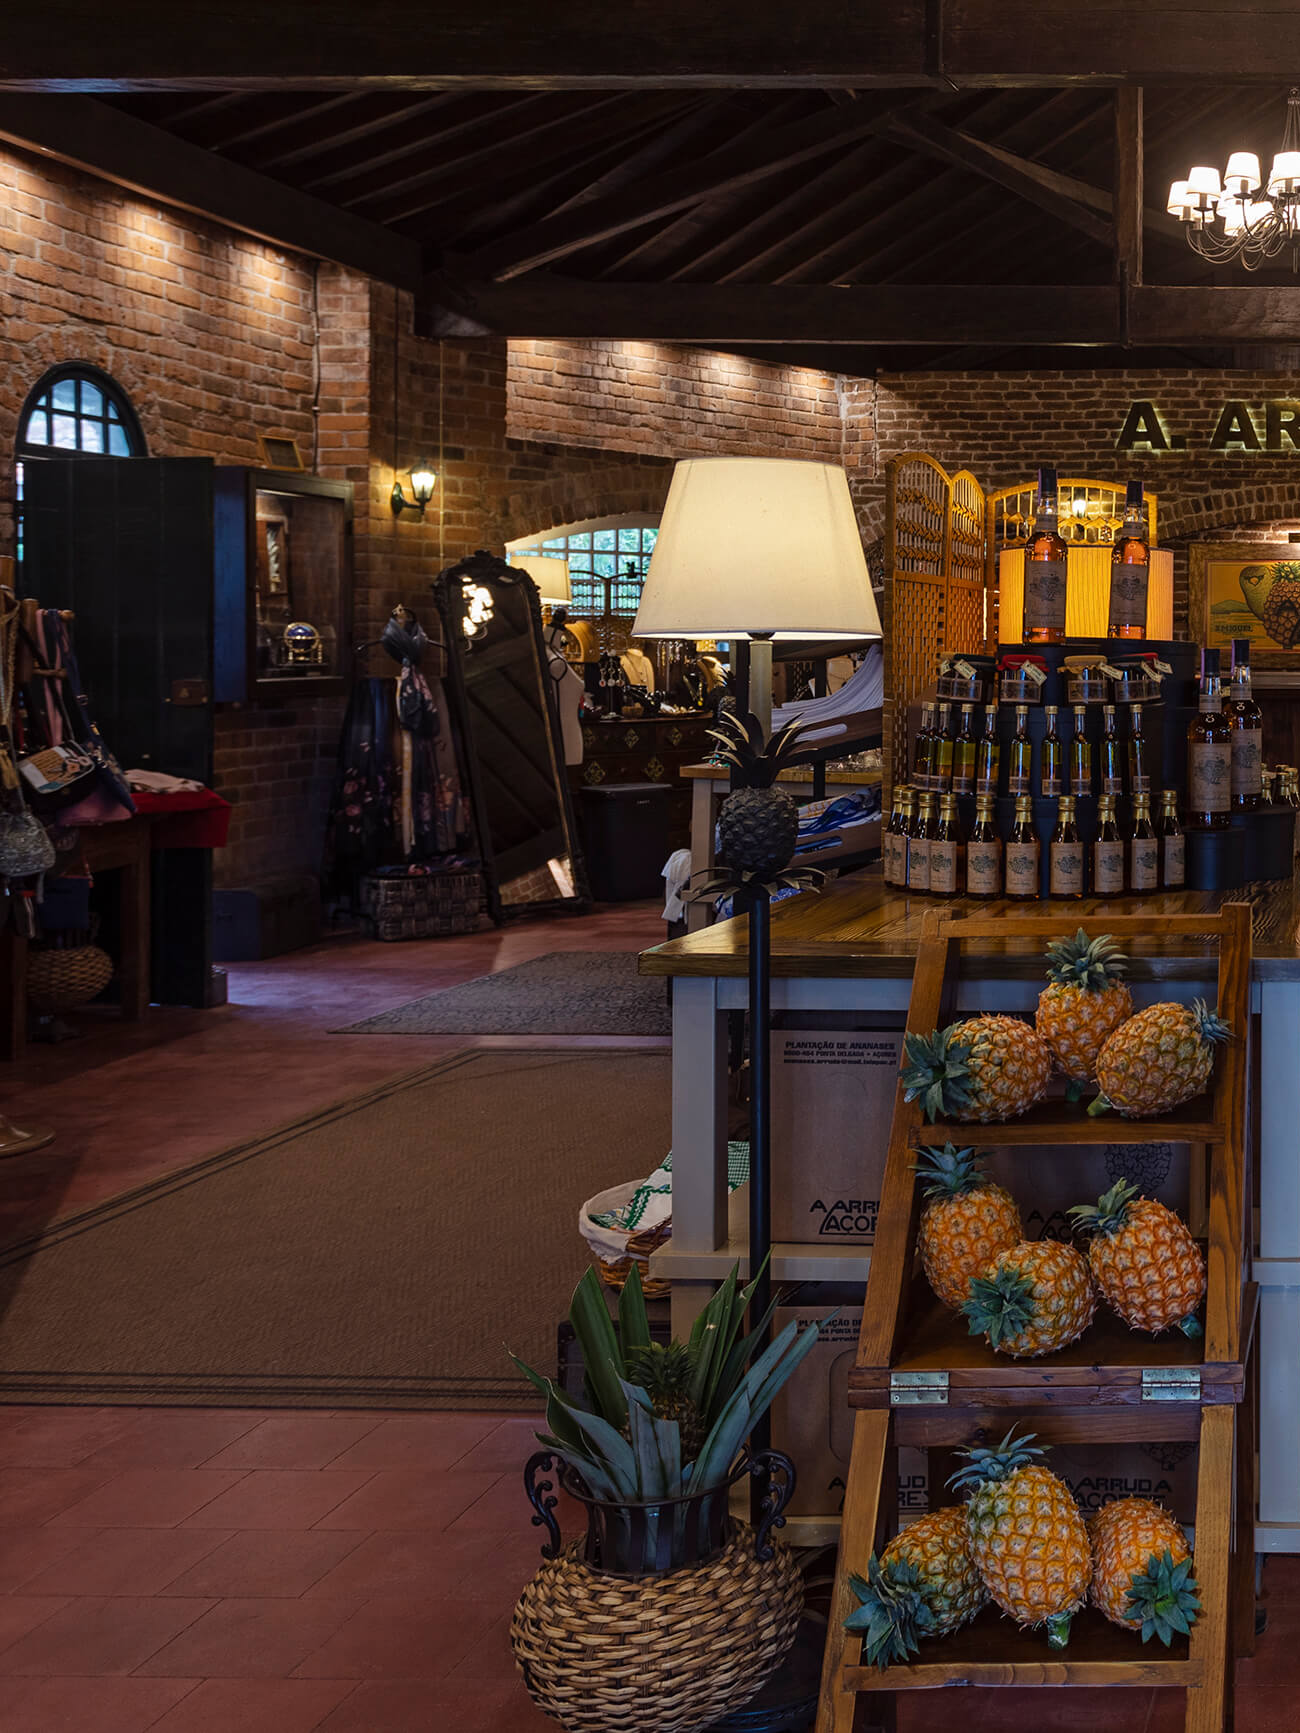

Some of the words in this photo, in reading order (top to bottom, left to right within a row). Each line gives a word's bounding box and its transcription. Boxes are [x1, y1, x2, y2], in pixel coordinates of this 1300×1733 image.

[1115, 400, 1187, 450] A.
[785, 1040, 835, 1051] PLANTAÇÃO
[837, 1042, 847, 1050] DE
[849, 1042, 896, 1050] ANANASES
[826, 1199, 880, 1214] ARR
[1073, 1477, 1173, 1493] ARRUDA
